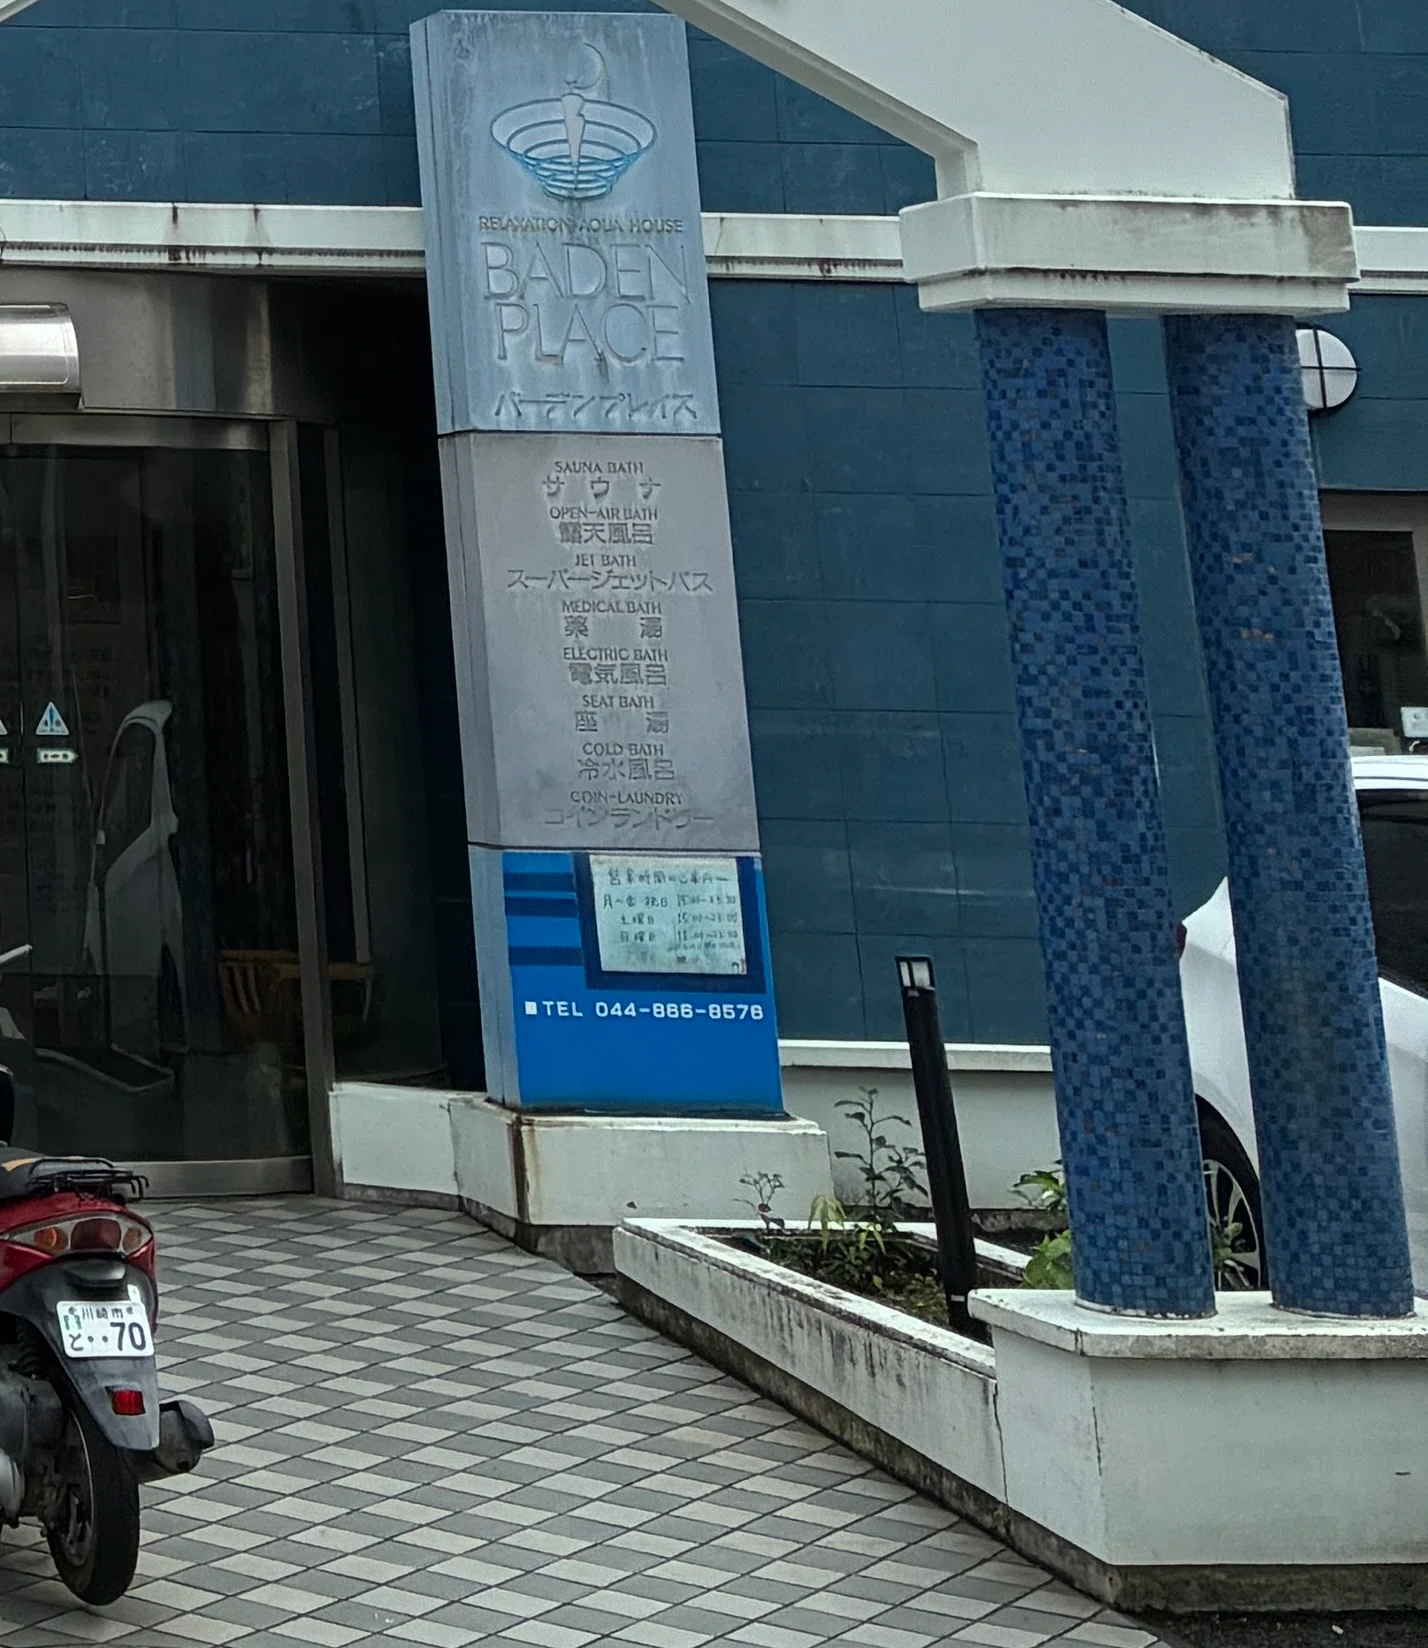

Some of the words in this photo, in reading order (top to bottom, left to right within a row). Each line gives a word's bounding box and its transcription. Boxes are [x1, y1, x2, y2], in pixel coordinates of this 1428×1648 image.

[478, 215, 571, 233] RELAXATION
[629, 218, 684, 234] HOUSE
[480, 240, 691, 304] BADEN
[495, 303, 684, 363] PLACE
[494, 391, 697, 419] バーデンプレイス
[554, 460, 603, 473] SAUNA
[607, 460, 643, 473] BATH
[542, 474, 661, 499] サウナ
[549, 505, 620, 519] OPEN-AIR
[624, 506, 658, 520] BATH
[559, 521, 653, 544] 露天風呂
[575, 554, 594, 567] JET
[601, 554, 636, 567] BATH
[507, 567, 713, 592] スーパージェットバス
[562, 600, 625, 613] MEDICAL
[626, 600, 662, 614] BATH
[563, 647, 629, 661] ELECTRIC
[633, 648, 668, 662] BATH
[569, 663, 667, 685] 電気風呂
[582, 694, 615, 708] SEAT
[618, 695, 654, 709] BATH
[582, 742, 624, 755] COLD
[628, 743, 664, 756] BATH
[577, 757, 675, 781] 冷水風呂
[570, 790, 682, 805] COIN-LAUNDRY
[545, 805, 714, 830] コインランドリー
[542, 1001, 583, 1016] TEL
